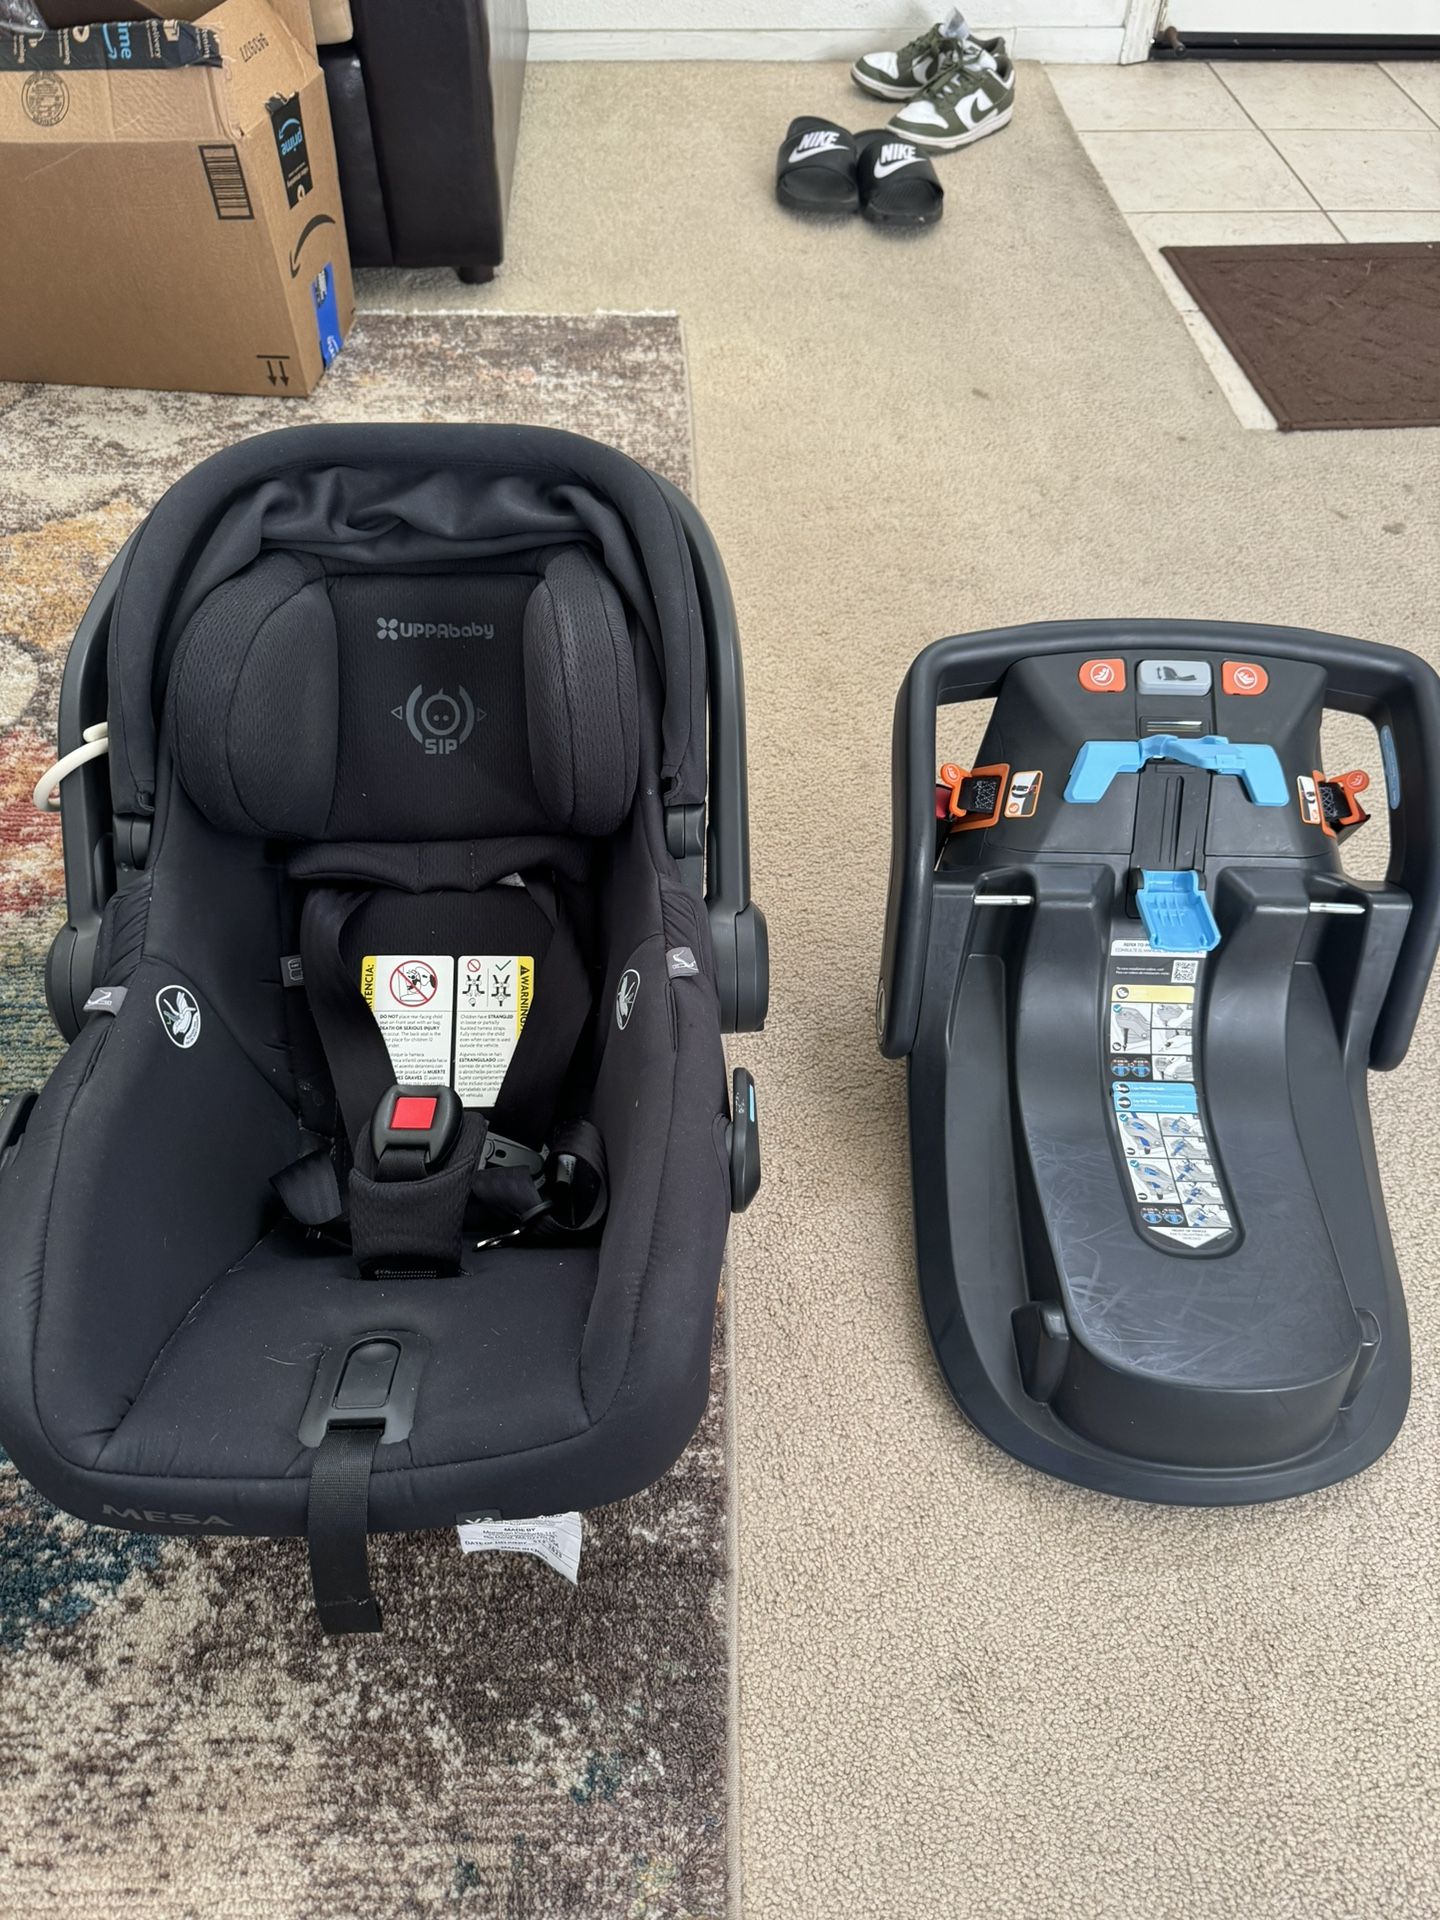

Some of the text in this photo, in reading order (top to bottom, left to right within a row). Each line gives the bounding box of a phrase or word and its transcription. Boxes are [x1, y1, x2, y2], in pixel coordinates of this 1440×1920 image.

[117, 21, 132, 59] ime
[281, 126, 303, 155] prime
[799, 131, 841, 150] NIKE
[881, 143, 917, 164] NIKE
[424, 738, 458, 755] SIP
[102, 1504, 235, 1526] MESA
